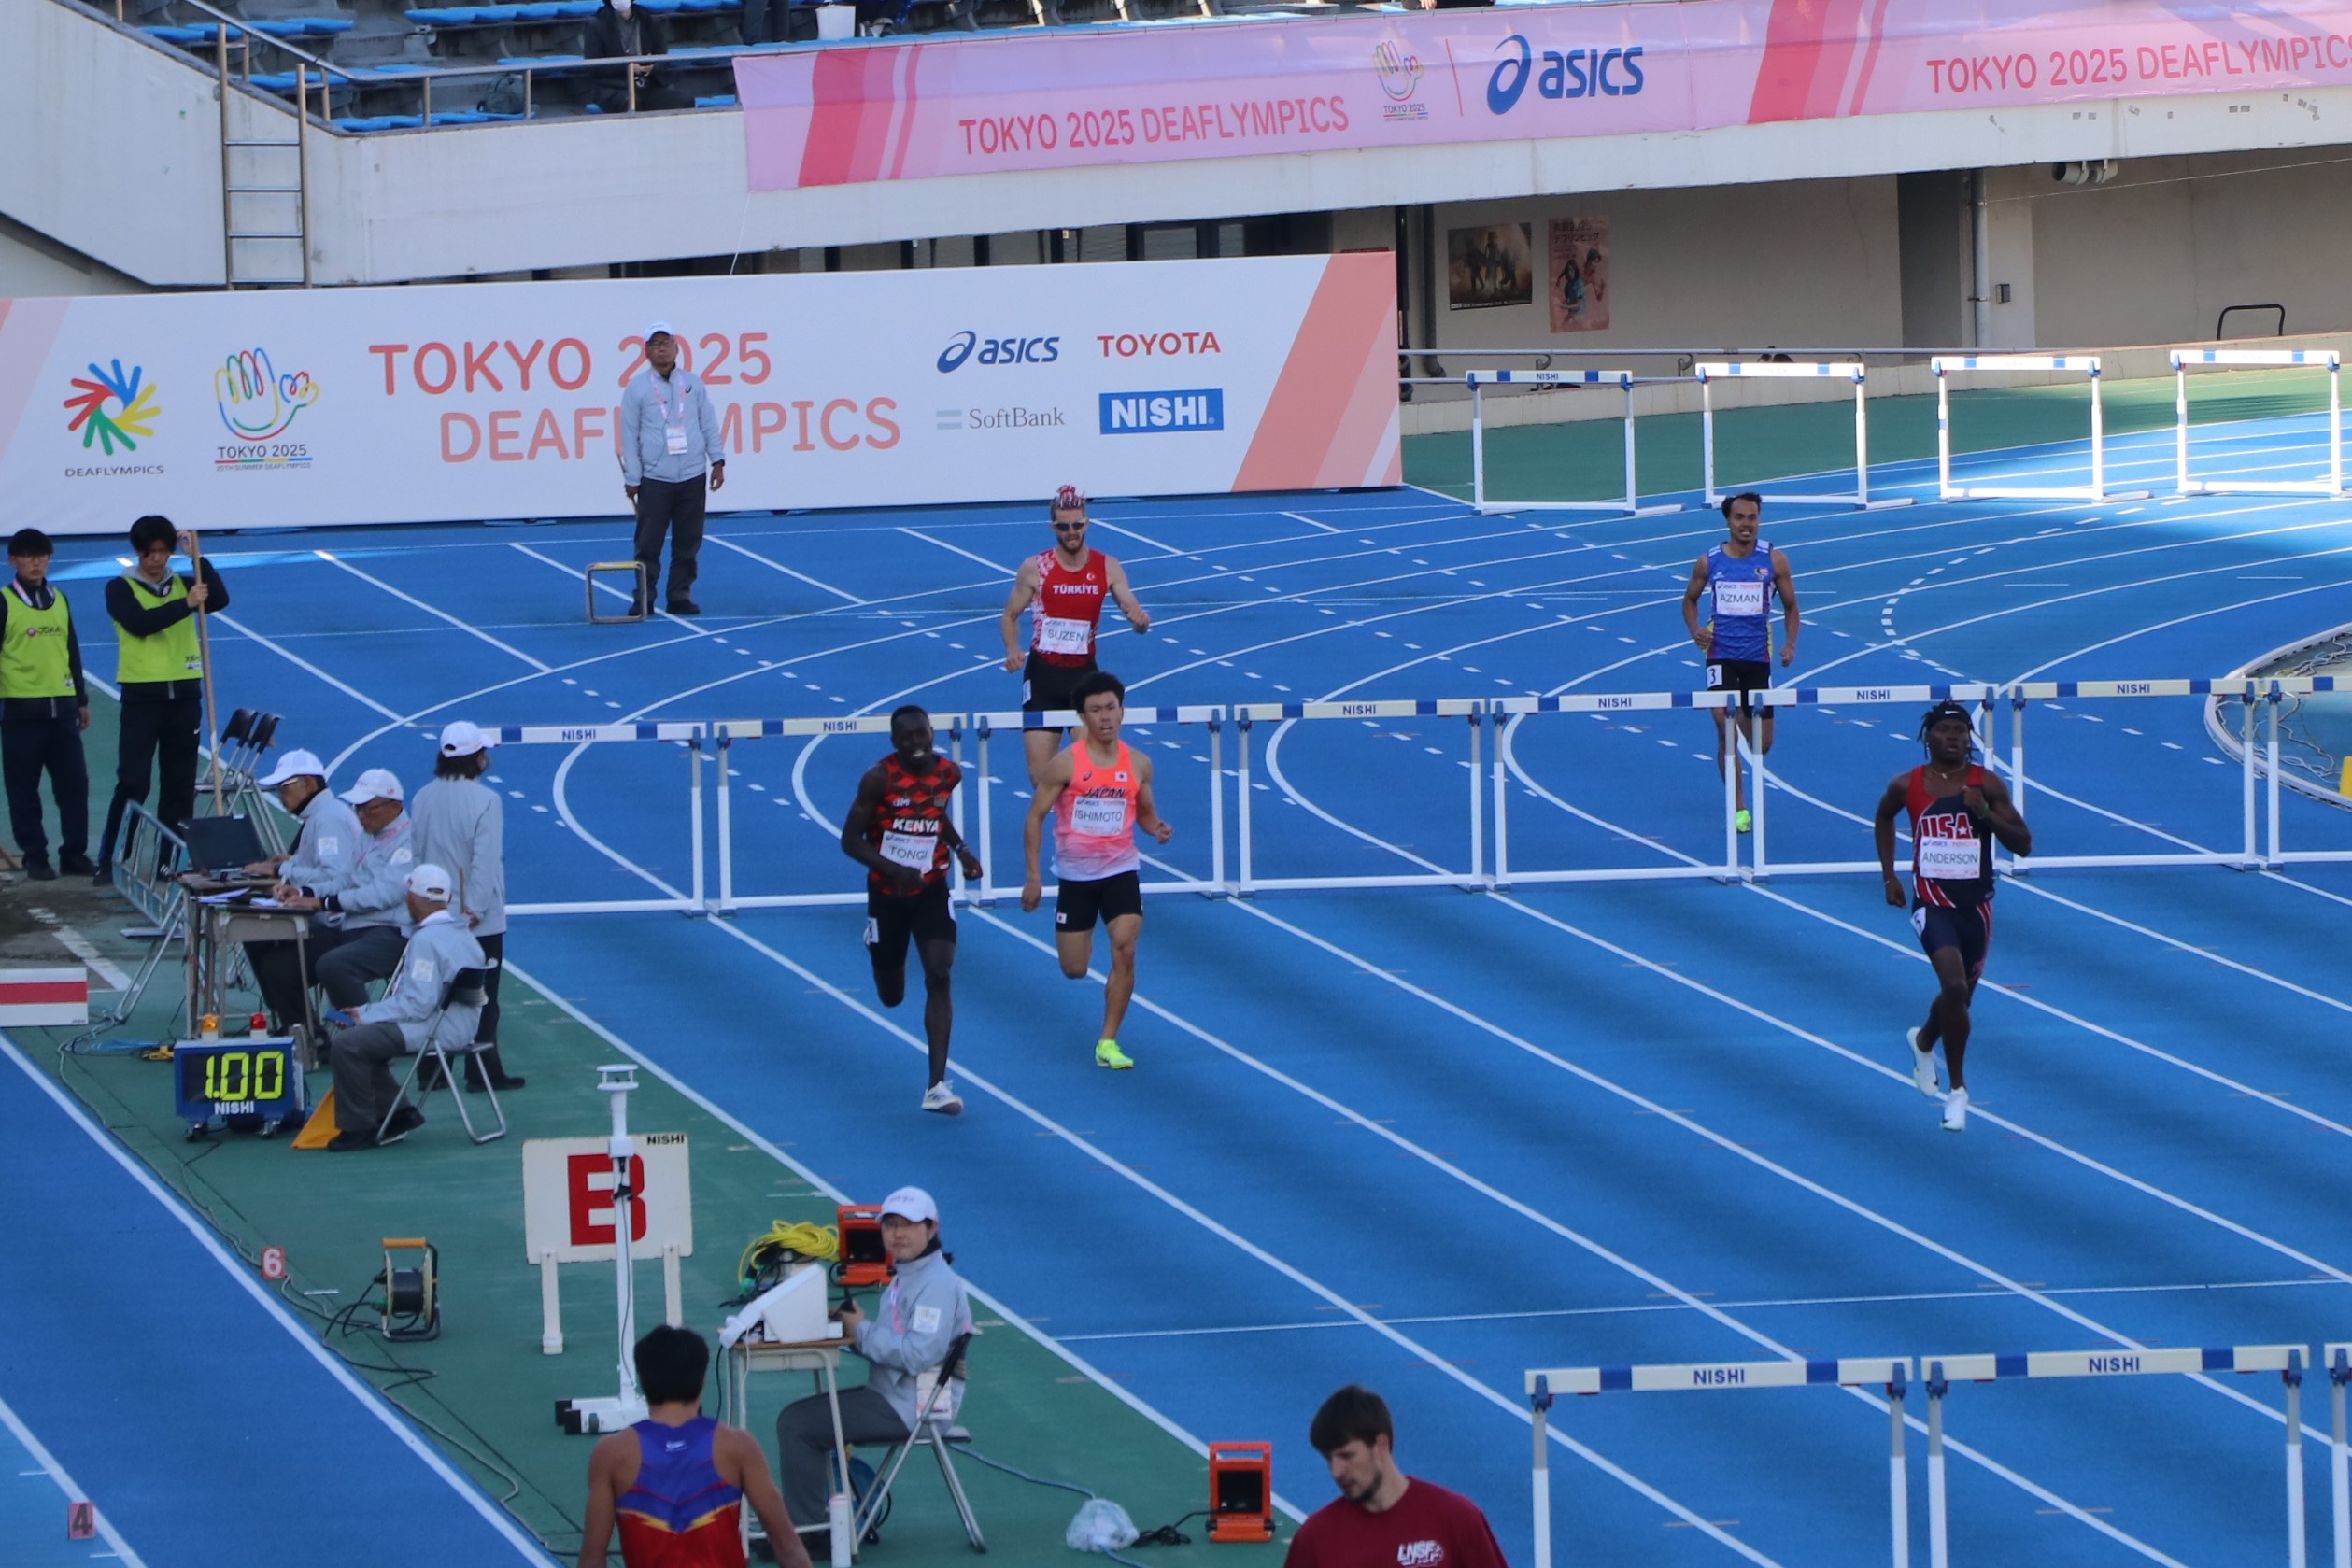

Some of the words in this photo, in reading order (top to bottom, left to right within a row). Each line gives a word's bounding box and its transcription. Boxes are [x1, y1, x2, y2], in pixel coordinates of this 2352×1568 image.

[1927, 52, 2037, 93] TOKYO
[2049, 48, 2127, 86] 2025
[1383, 105, 1408, 113] TOKYO
[1409, 103, 1425, 112] 2025
[959, 114, 1057, 155] TOKYO
[1068, 109, 1135, 148] 2025
[1142, 95, 1349, 143] DEAFLYMPICS
[1097, 332, 1221, 358] TOYOTA
[369, 337, 591, 396] TOKYO
[1537, 373, 1559, 381] NISHI
[969, 407, 1065, 430] SoftBank
[1112, 395, 1208, 429] NISHI
[217, 445, 267, 459] TOKYO
[272, 444, 306, 457] 2025
[65, 465, 164, 477] DEAFLYMPICS
[1720, 593, 1760, 603] AZMAN
[1048, 629, 1084, 642] SUZEN
[1708, 668, 1717, 685] 3
[1857, 689, 1891, 701] NISHI
[2117, 683, 2150, 695] NISHI
[1342, 704, 1376, 716] NISHI
[1598, 697, 1632, 709] NISHI
[823, 720, 857, 732] NISHI
[561, 728, 597, 742] NISHI
[1086, 787, 1126, 798] JAPAN
[1075, 809, 1123, 823] ISHIMOTO
[892, 818, 939, 833] KENYA
[1920, 812, 1974, 840] USA
[890, 845, 928, 860] TONGI
[1922, 852, 1978, 865] ANDERSON
[205, 1051, 284, 1100] 1.00
[214, 1100, 255, 1115] NISHI
[647, 1133, 685, 1146] NISHI
[263, 1248, 282, 1278] 6
[2089, 1355, 2141, 1373] NISHI
[1693, 1367, 1746, 1386] NISHI
[72, 1503, 92, 1536] 4
